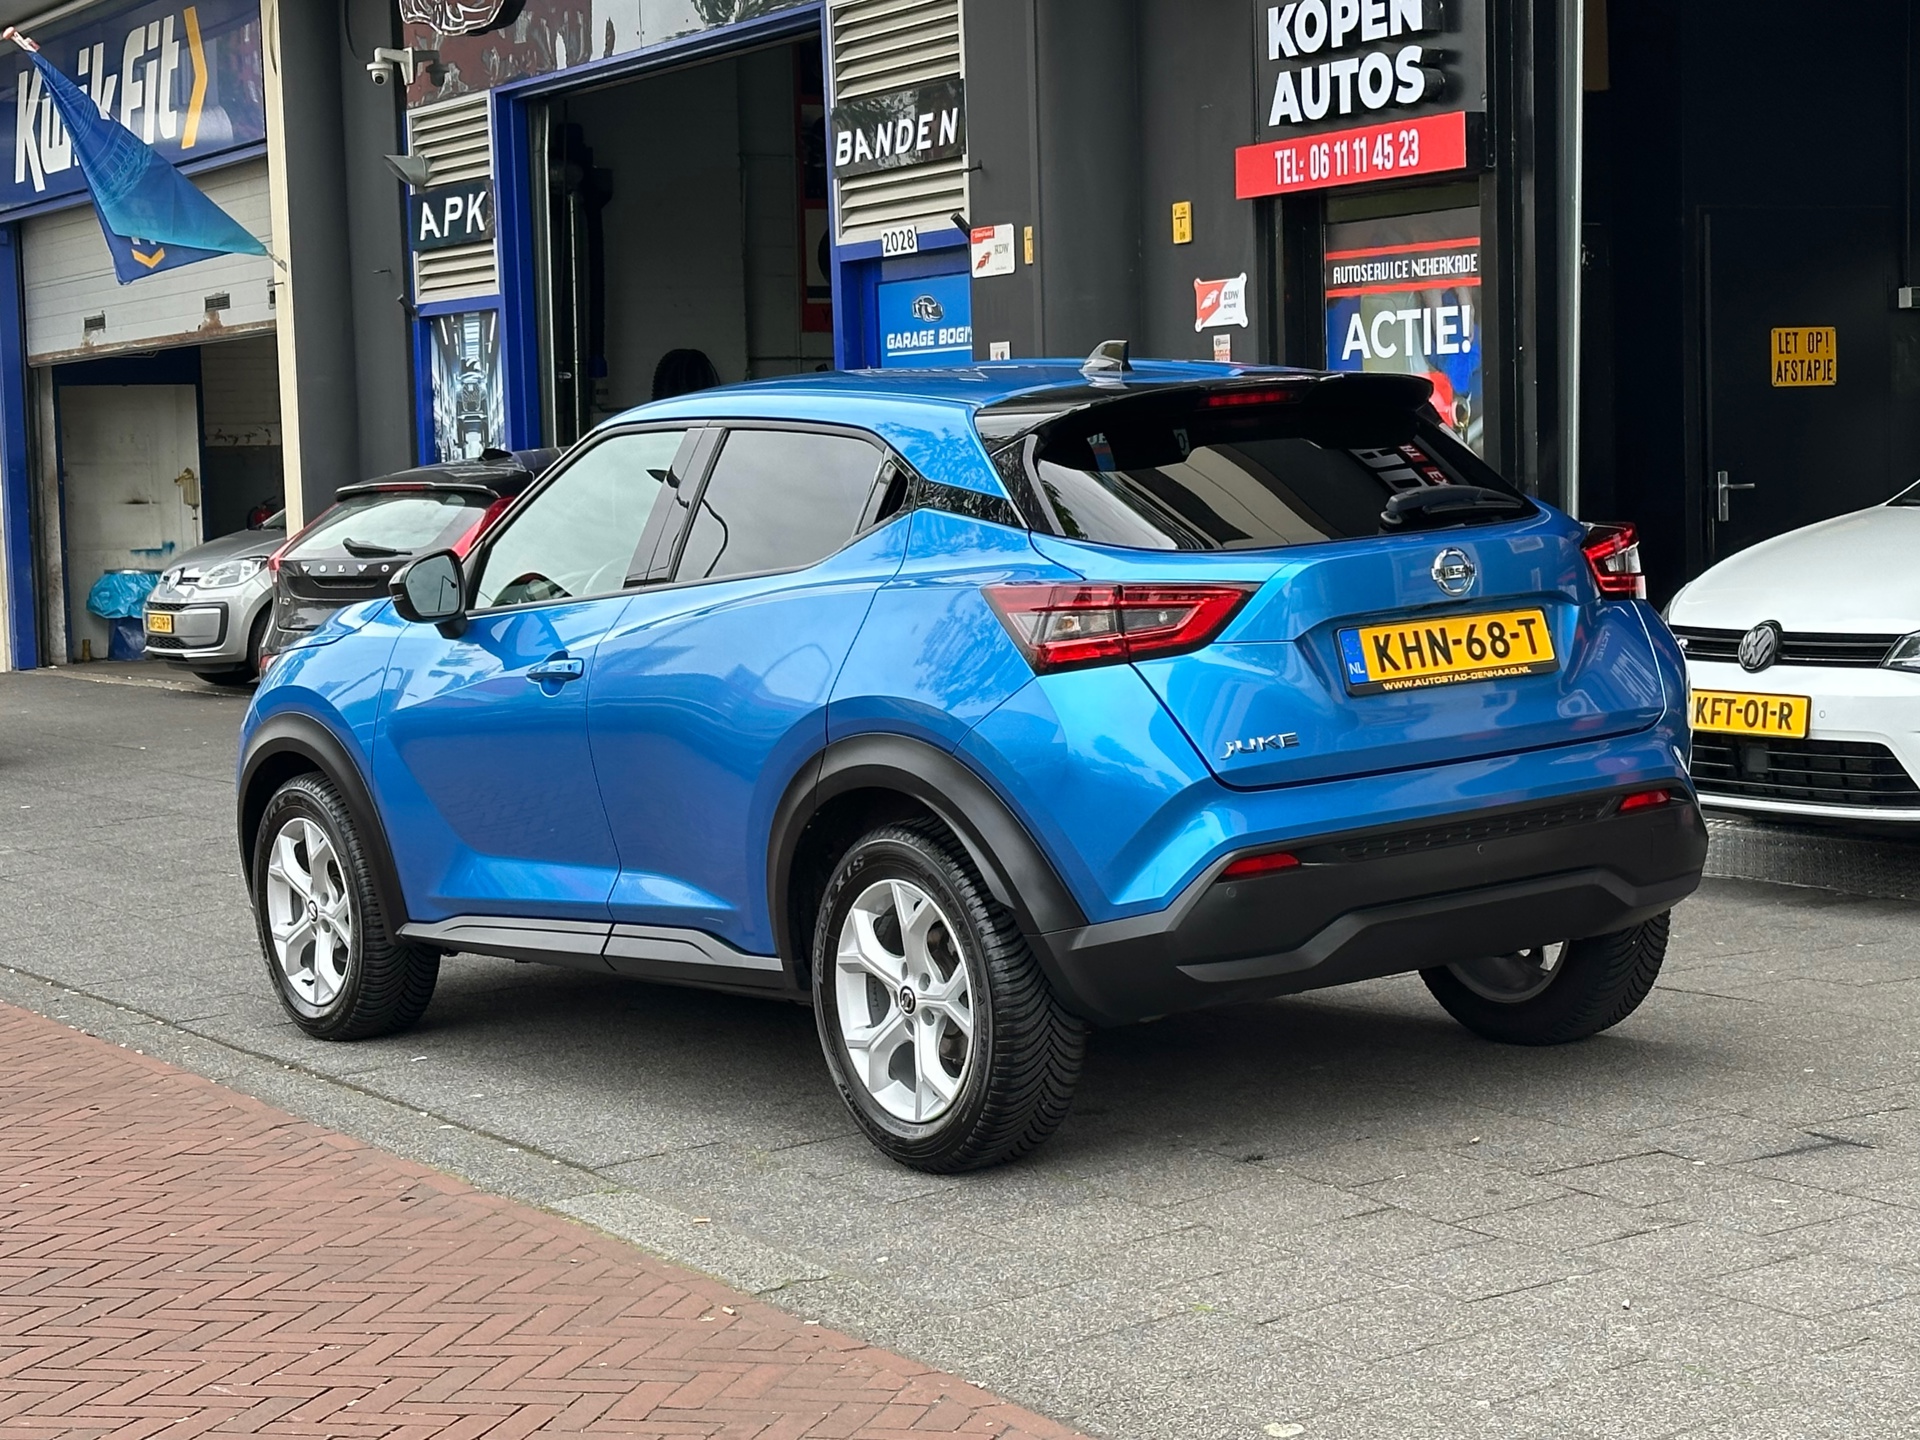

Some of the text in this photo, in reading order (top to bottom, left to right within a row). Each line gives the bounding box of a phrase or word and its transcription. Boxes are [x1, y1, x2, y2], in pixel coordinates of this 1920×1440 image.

[1268, 0, 1423, 60] KOPEN
[1268, 45, 1425, 126] AUTOS
[835, 107, 958, 167] BANDEN
[1274, 128, 1419, 185] TEL: 06 11 11 45 23
[420, 191, 487, 241] APK
[883, 229, 915, 253] 2028
[1333, 253, 1478, 285] AUTOSERVICE NEHERKADE
[887, 329, 934, 349] GARAGE
[1341, 304, 1471, 361] ACTIE!
[1778, 331, 1828, 354] LET OP!
[1776, 359, 1833, 382] AFSTAPJE
[301, 564, 390, 573] VOLVO
[1372, 618, 1538, 673] KHN-68-T
[1349, 662, 1365, 675] NL
[1382, 666, 1532, 691] WWW.AUTOSTAD-DENHAAG.NL
[1695, 696, 1793, 730] KFT-01-R
[1220, 731, 1300, 760] JUKE
